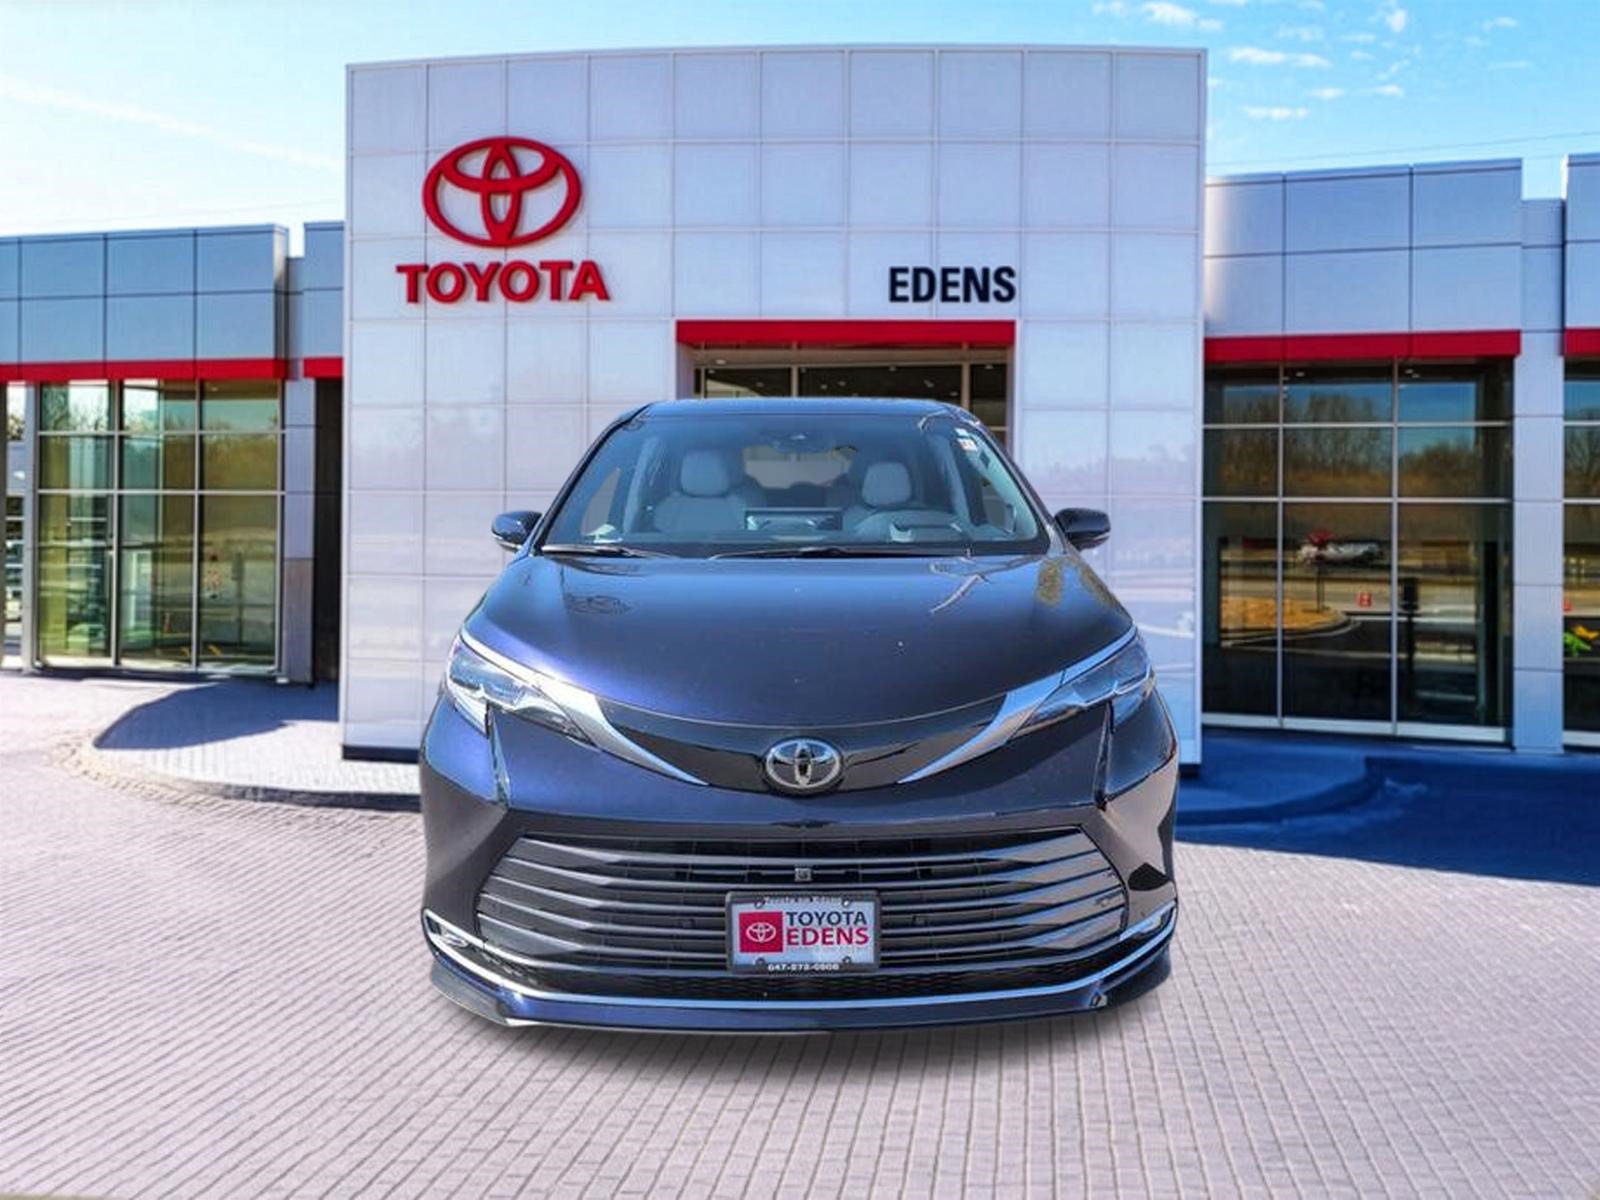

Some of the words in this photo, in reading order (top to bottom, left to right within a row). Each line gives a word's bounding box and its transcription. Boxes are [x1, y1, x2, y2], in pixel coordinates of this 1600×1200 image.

[396, 260, 611, 303] TOYOTA
[889, 266, 1016, 303] EDENS
[786, 911, 867, 926] TOYOTA
[786, 927, 869, 946] EDENS
